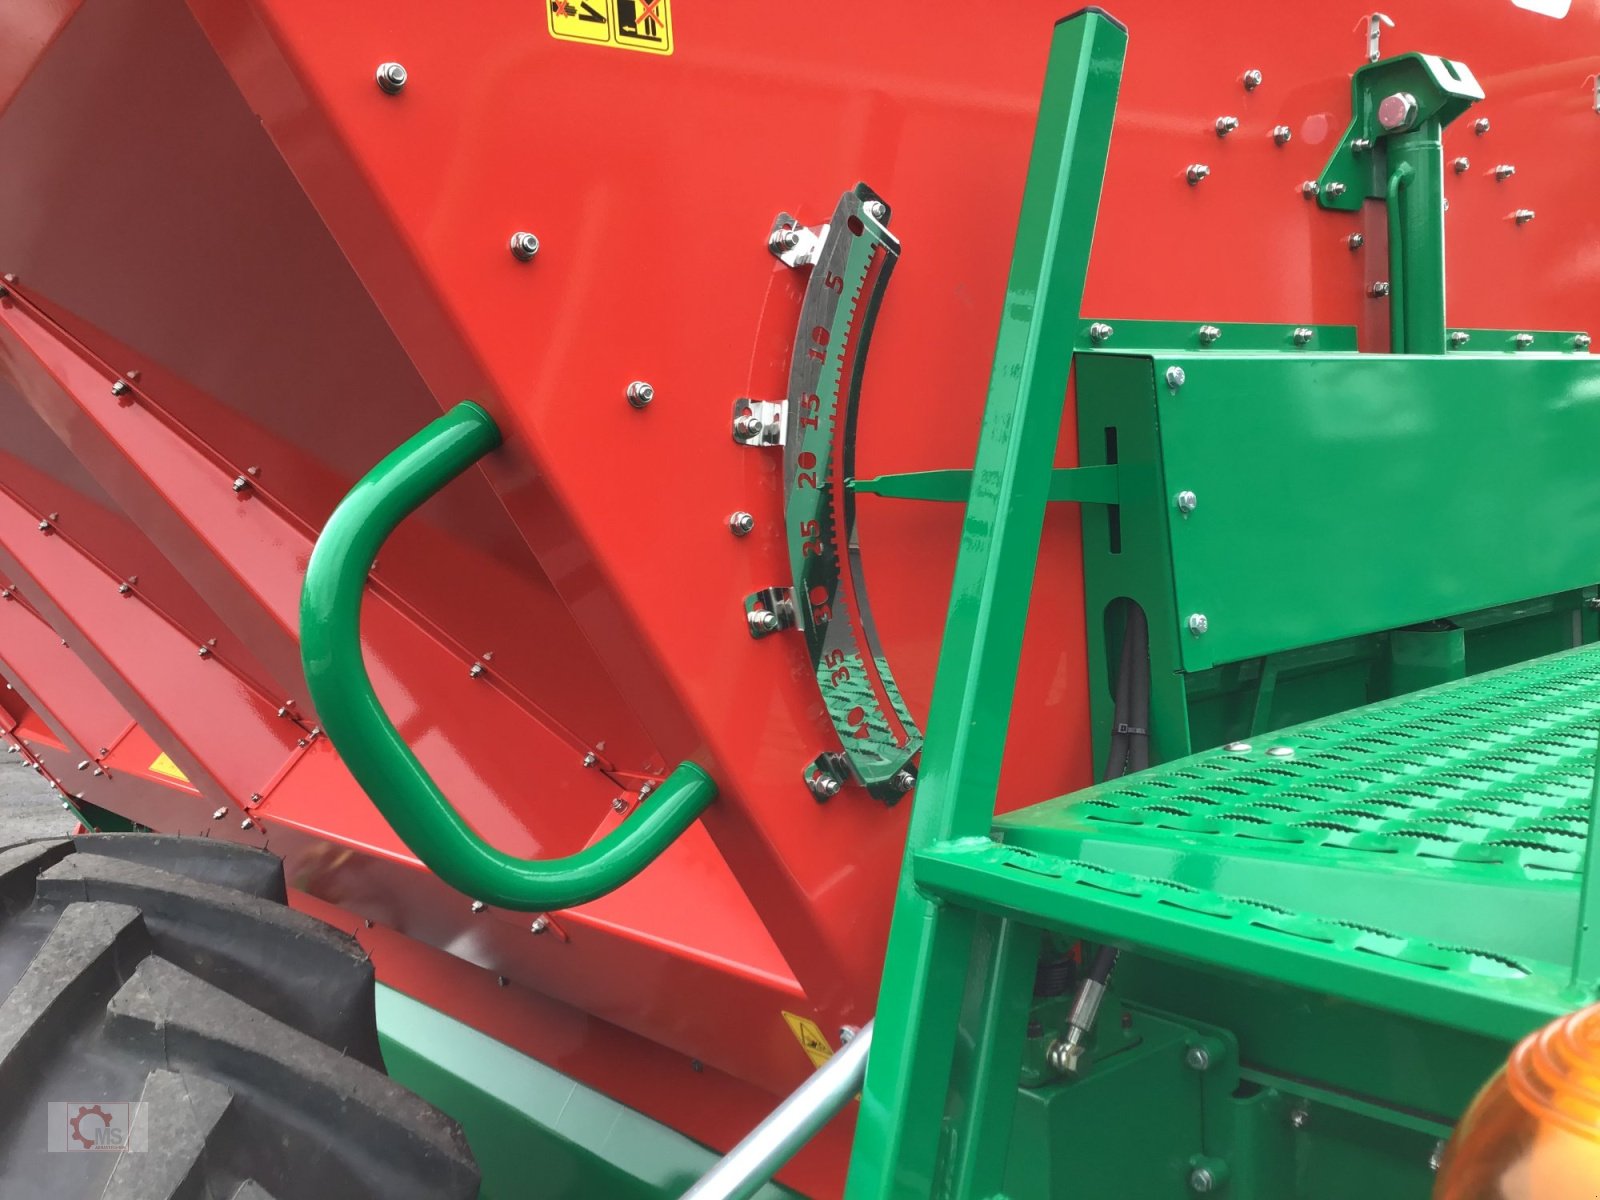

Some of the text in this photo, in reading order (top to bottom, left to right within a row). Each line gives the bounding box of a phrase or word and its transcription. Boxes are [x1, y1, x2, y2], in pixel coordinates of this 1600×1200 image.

[825, 271, 844, 295] 5
[808, 327, 830, 366] 10
[800, 391, 821, 432] 15
[797, 451, 817, 490] 20
[800, 518, 824, 558] 25
[810, 585, 833, 626] 30
[825, 648, 850, 688] 35
